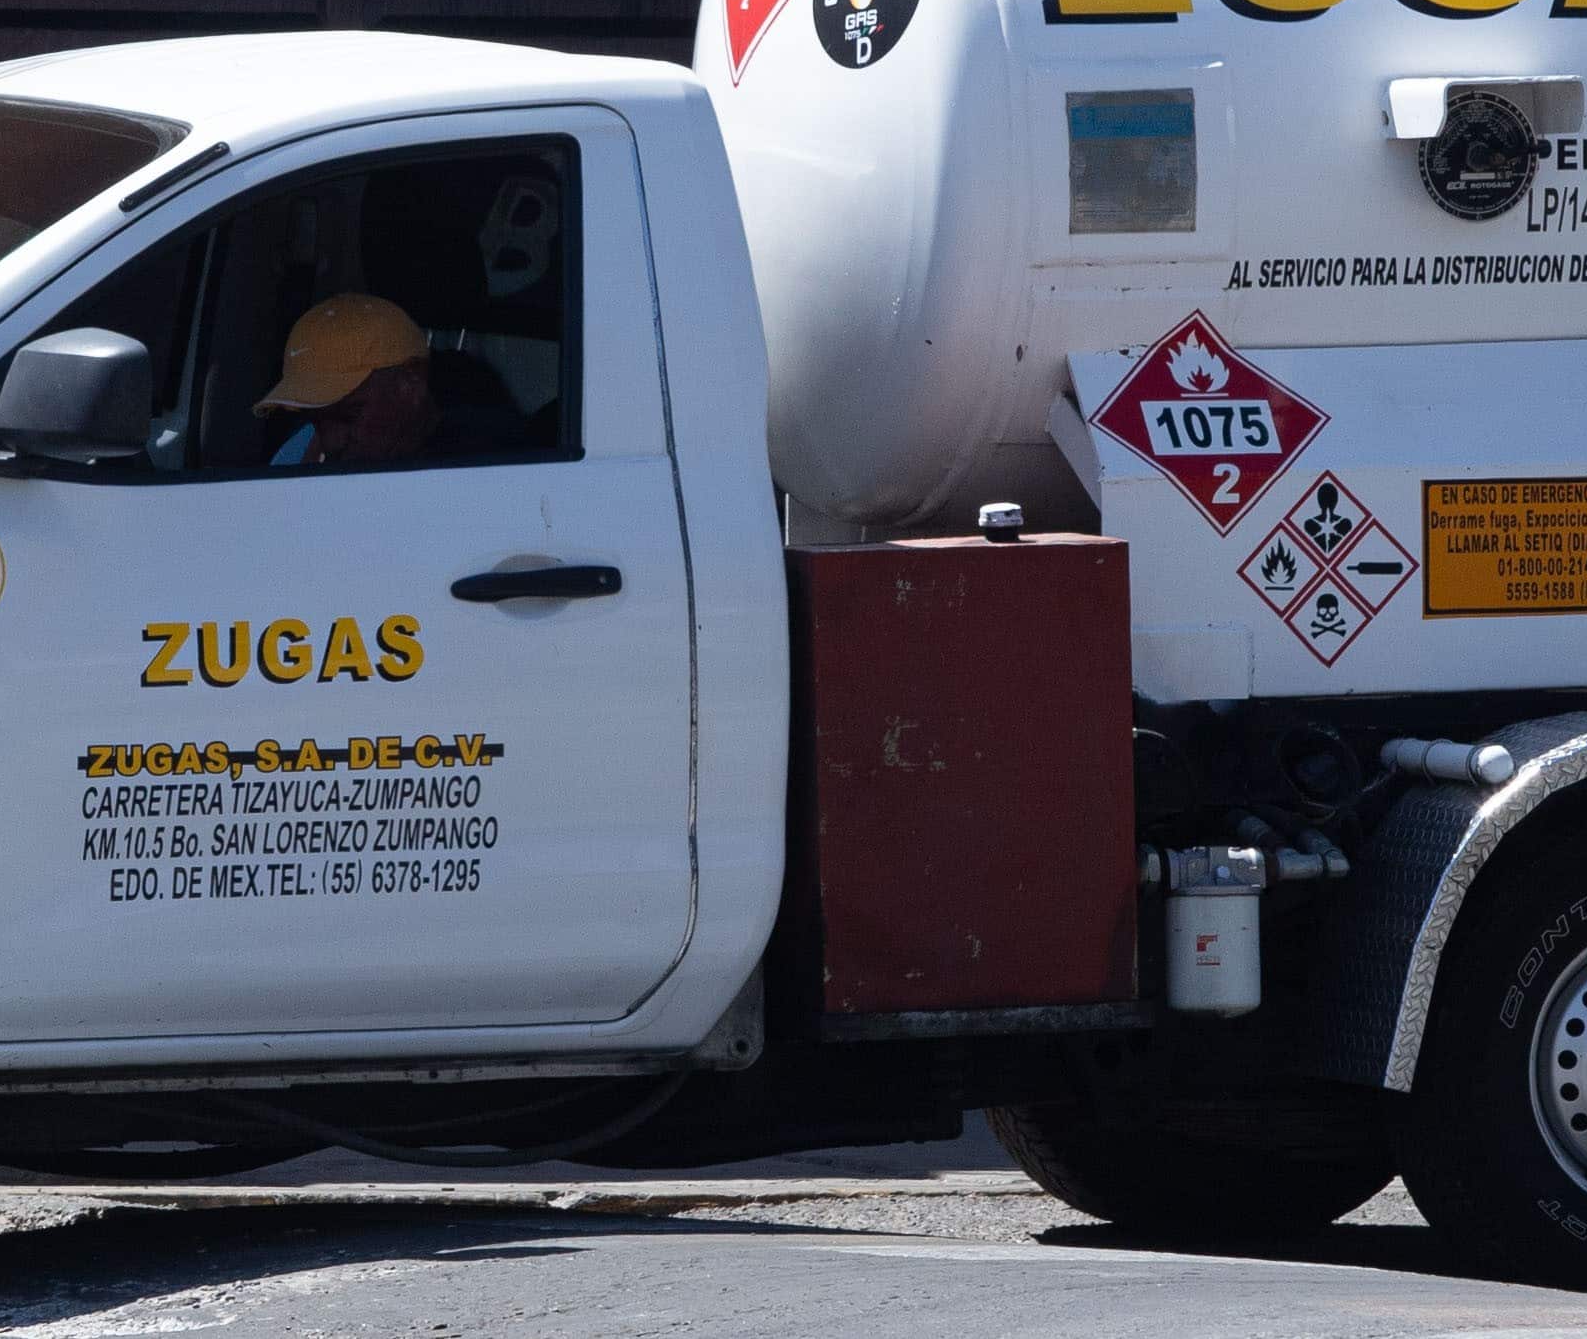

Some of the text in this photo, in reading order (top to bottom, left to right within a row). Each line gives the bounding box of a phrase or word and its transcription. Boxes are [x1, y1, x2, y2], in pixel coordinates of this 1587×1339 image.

[845, 8, 878, 31] GAS
[856, 36, 872, 65] D
[1228, 262, 1252, 290] AL
[1258, 258, 1347, 288] SERVICIO
[1351, 257, 1399, 287] PARA
[1402, 257, 1427, 286] LA
[1431, 254, 1568, 285] DISTRIBUCION
[1156, 406, 1270, 450] 1075
[1211, 463, 1242, 505] 2
[1441, 485, 1458, 505] EN
[1463, 484, 1497, 505] CASO
[1502, 484, 1518, 504] DE
[1430, 511, 1485, 530] Derrame
[1447, 533, 1499, 554] LLAMAR
[1504, 534, 1520, 553] AL
[1524, 533, 1563, 553] SETIQ
[140, 614, 427, 688] ZUGAS
[85, 733, 494, 780] ZUGAS, S.A. DE C.V.
[81, 774, 482, 820] CARRETERA TIZAYUCA-ZUMPANGO
[82, 815, 499, 861] KM.10.5 Bo. SAN LORENZO ZUMPANGO
[109, 868, 165, 903] EDO.
[171, 866, 203, 900] DE
[321, 859, 363, 896] (55)
[370, 858, 481, 894] 6378-1295
